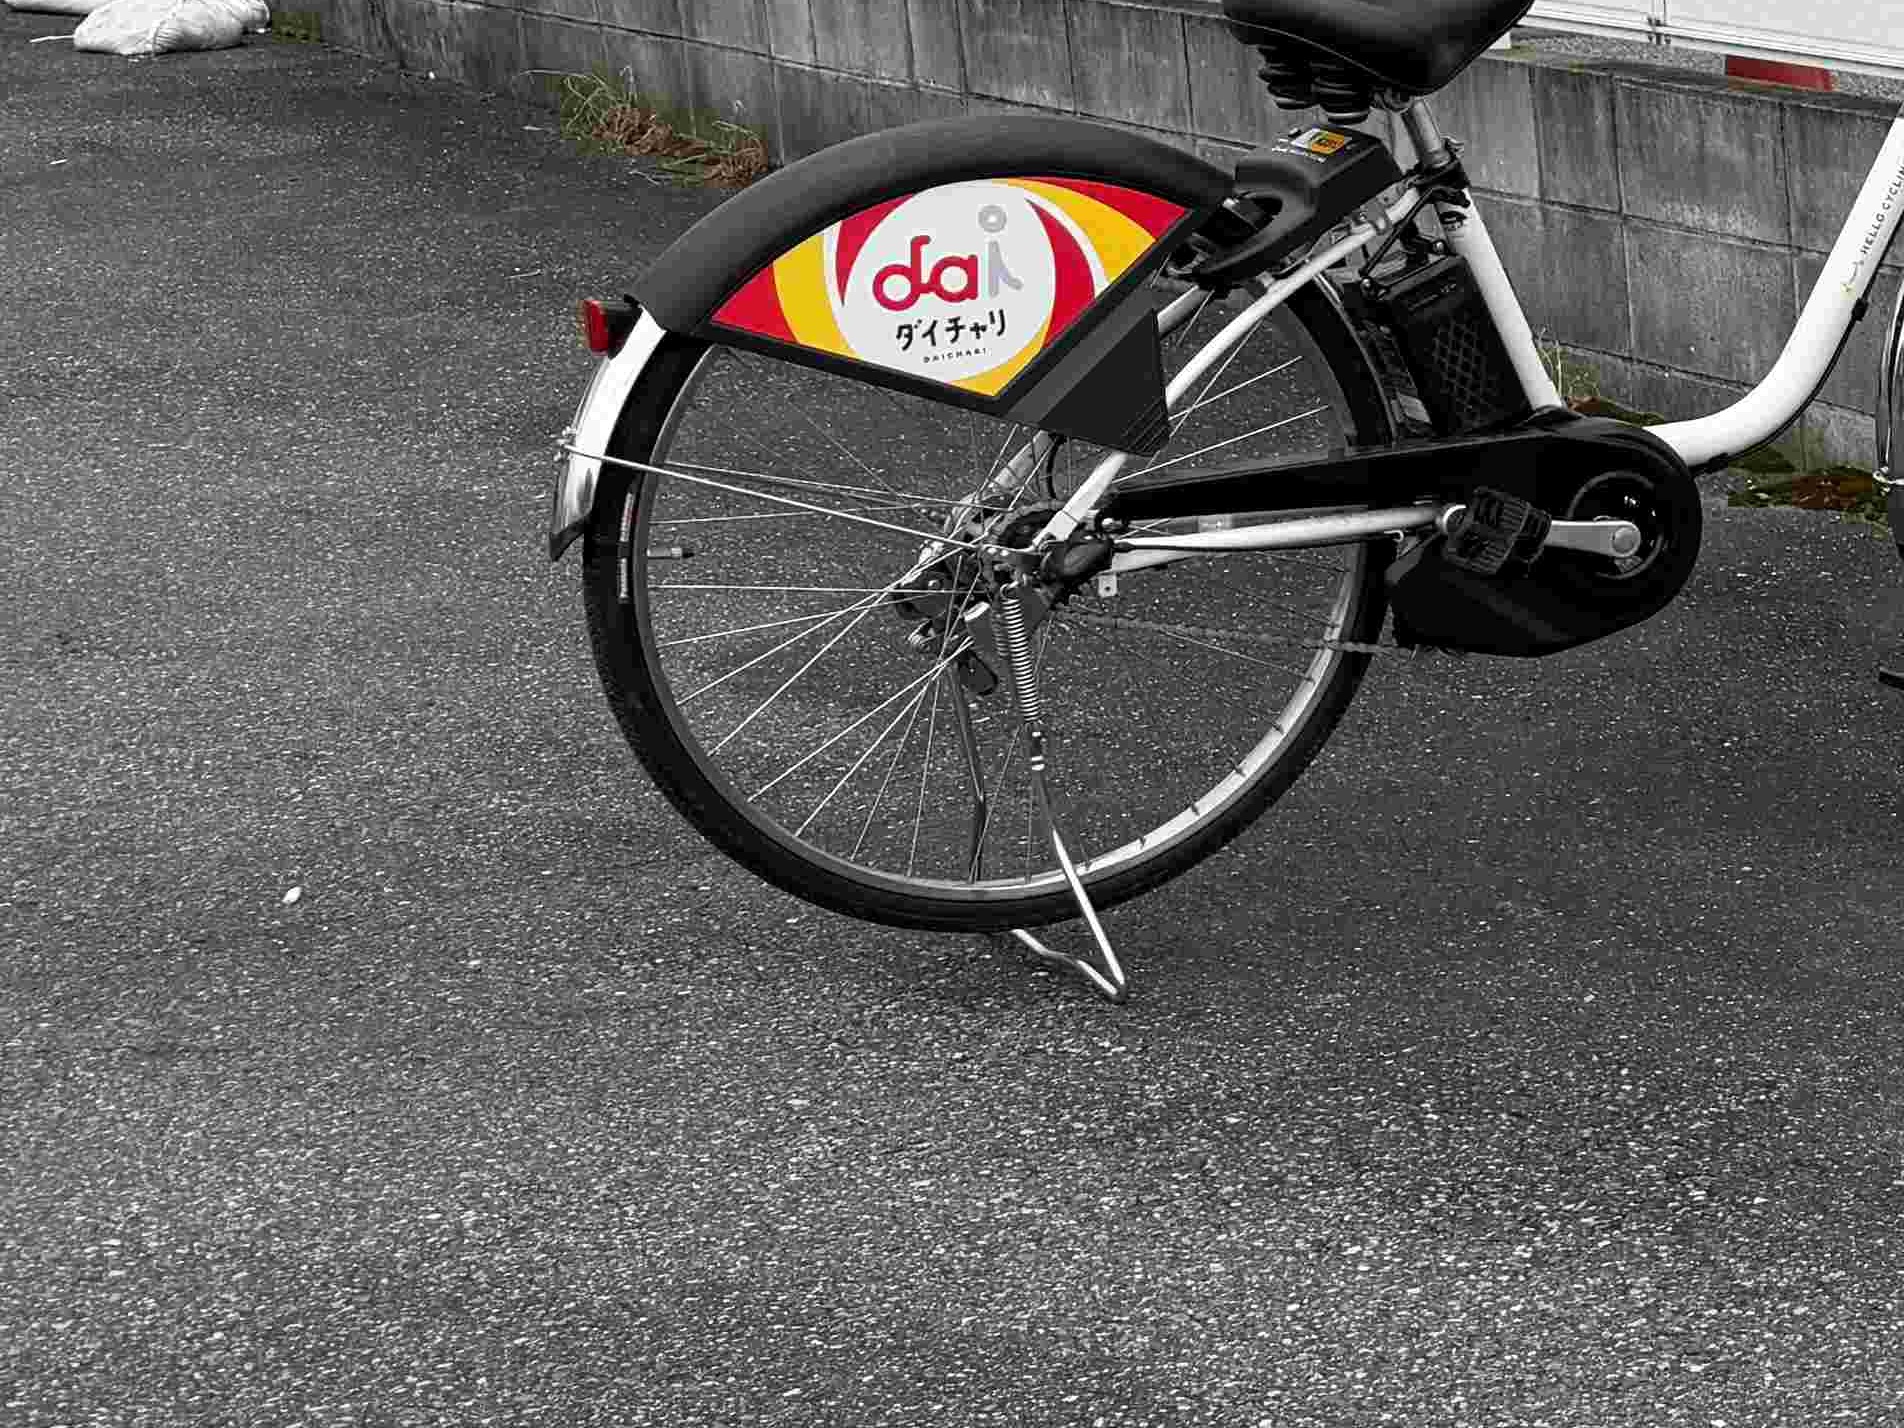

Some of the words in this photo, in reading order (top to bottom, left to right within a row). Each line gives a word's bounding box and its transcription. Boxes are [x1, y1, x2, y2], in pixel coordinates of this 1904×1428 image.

[1860, 212, 1885, 255] HELLO
[872, 204, 1023, 311] dai
[896, 308, 1007, 351] ダイチャリ
[923, 347, 987, 364] DAICHARI
